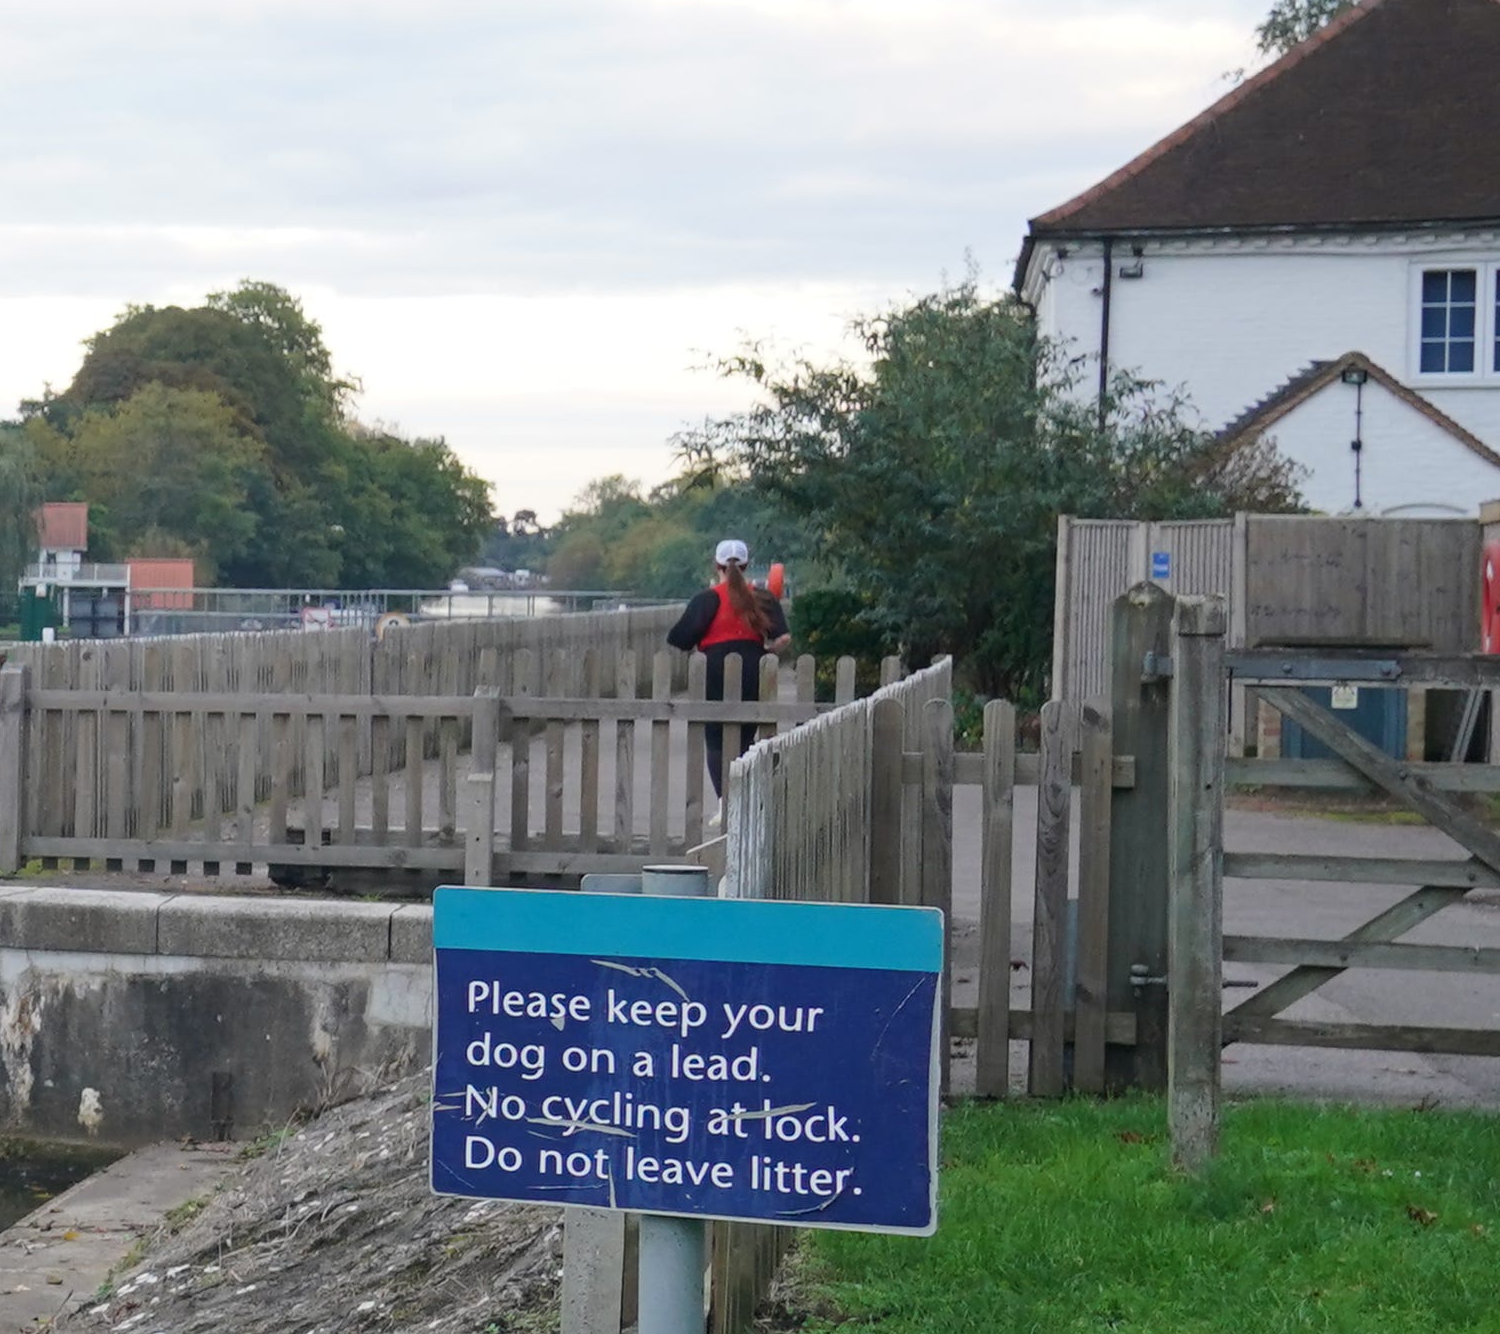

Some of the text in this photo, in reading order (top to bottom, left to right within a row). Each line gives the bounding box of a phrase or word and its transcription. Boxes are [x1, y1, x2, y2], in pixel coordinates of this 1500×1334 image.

[467, 979, 825, 1040] Please keep your
[465, 1031, 772, 1083] dog on a lead.
[464, 1084, 861, 1144] No cycling at lock.
[464, 1134, 863, 1197] Do not leave litter.
